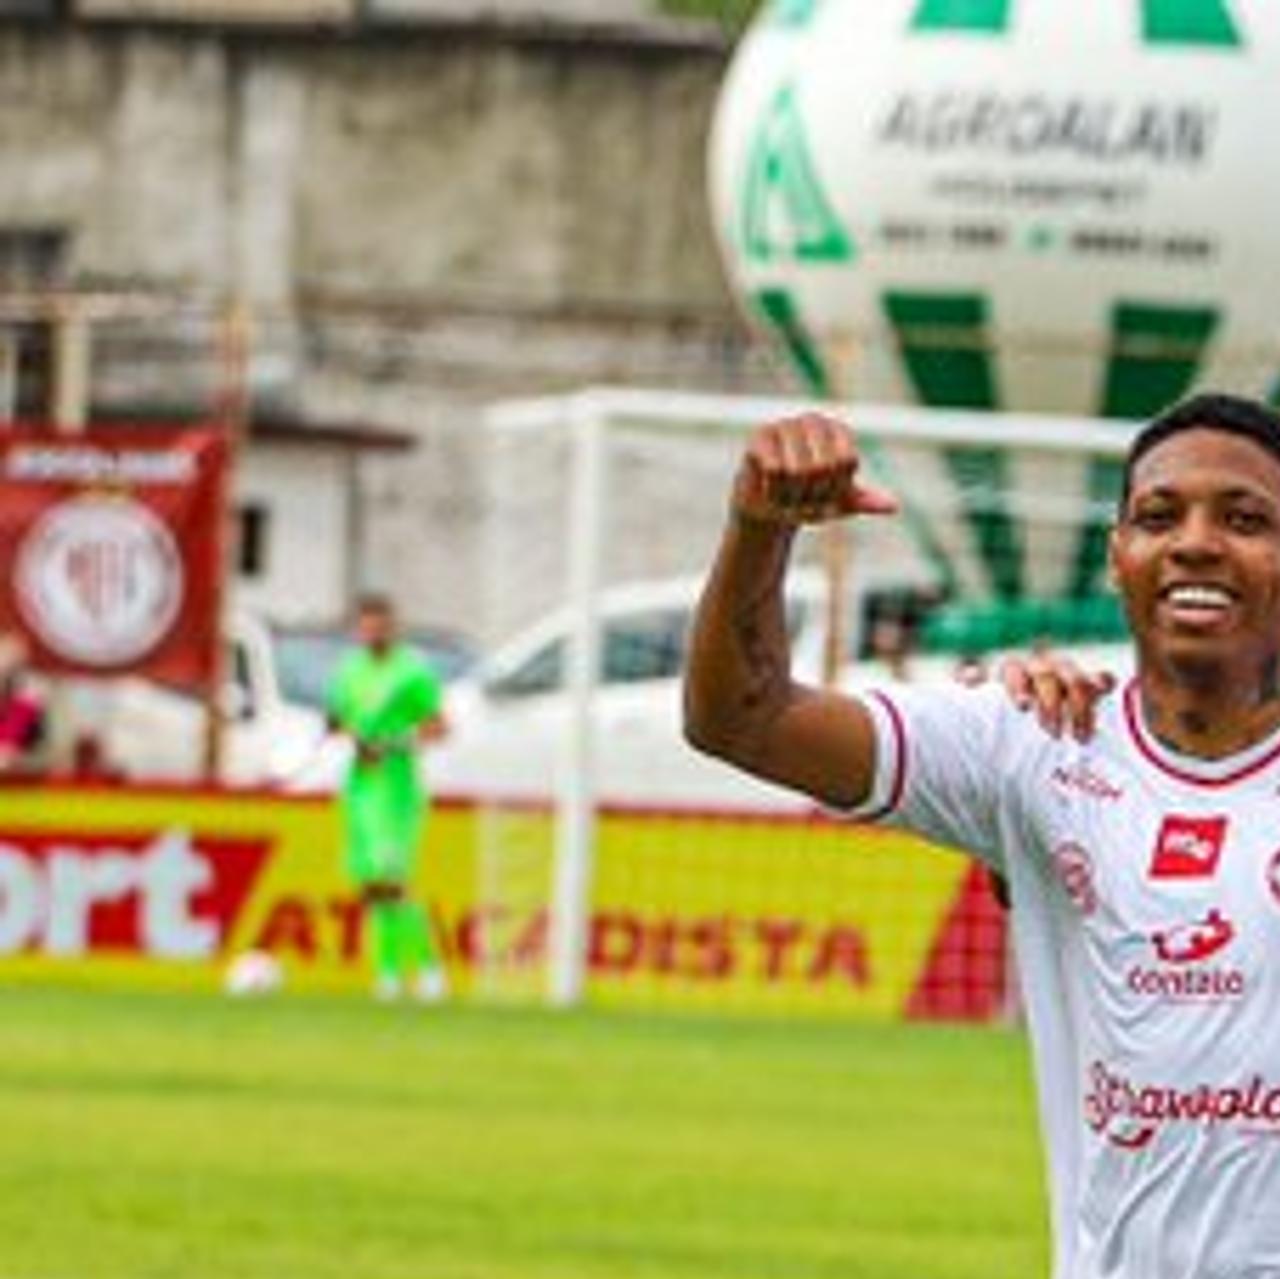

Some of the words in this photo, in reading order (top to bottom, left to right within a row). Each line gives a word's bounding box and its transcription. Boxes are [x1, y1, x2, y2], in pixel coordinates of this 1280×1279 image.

[876, 92, 1219, 166] AGROALAN
[254, 890, 873, 988] ATCADISTA
[1127, 968, 1244, 995] contato
